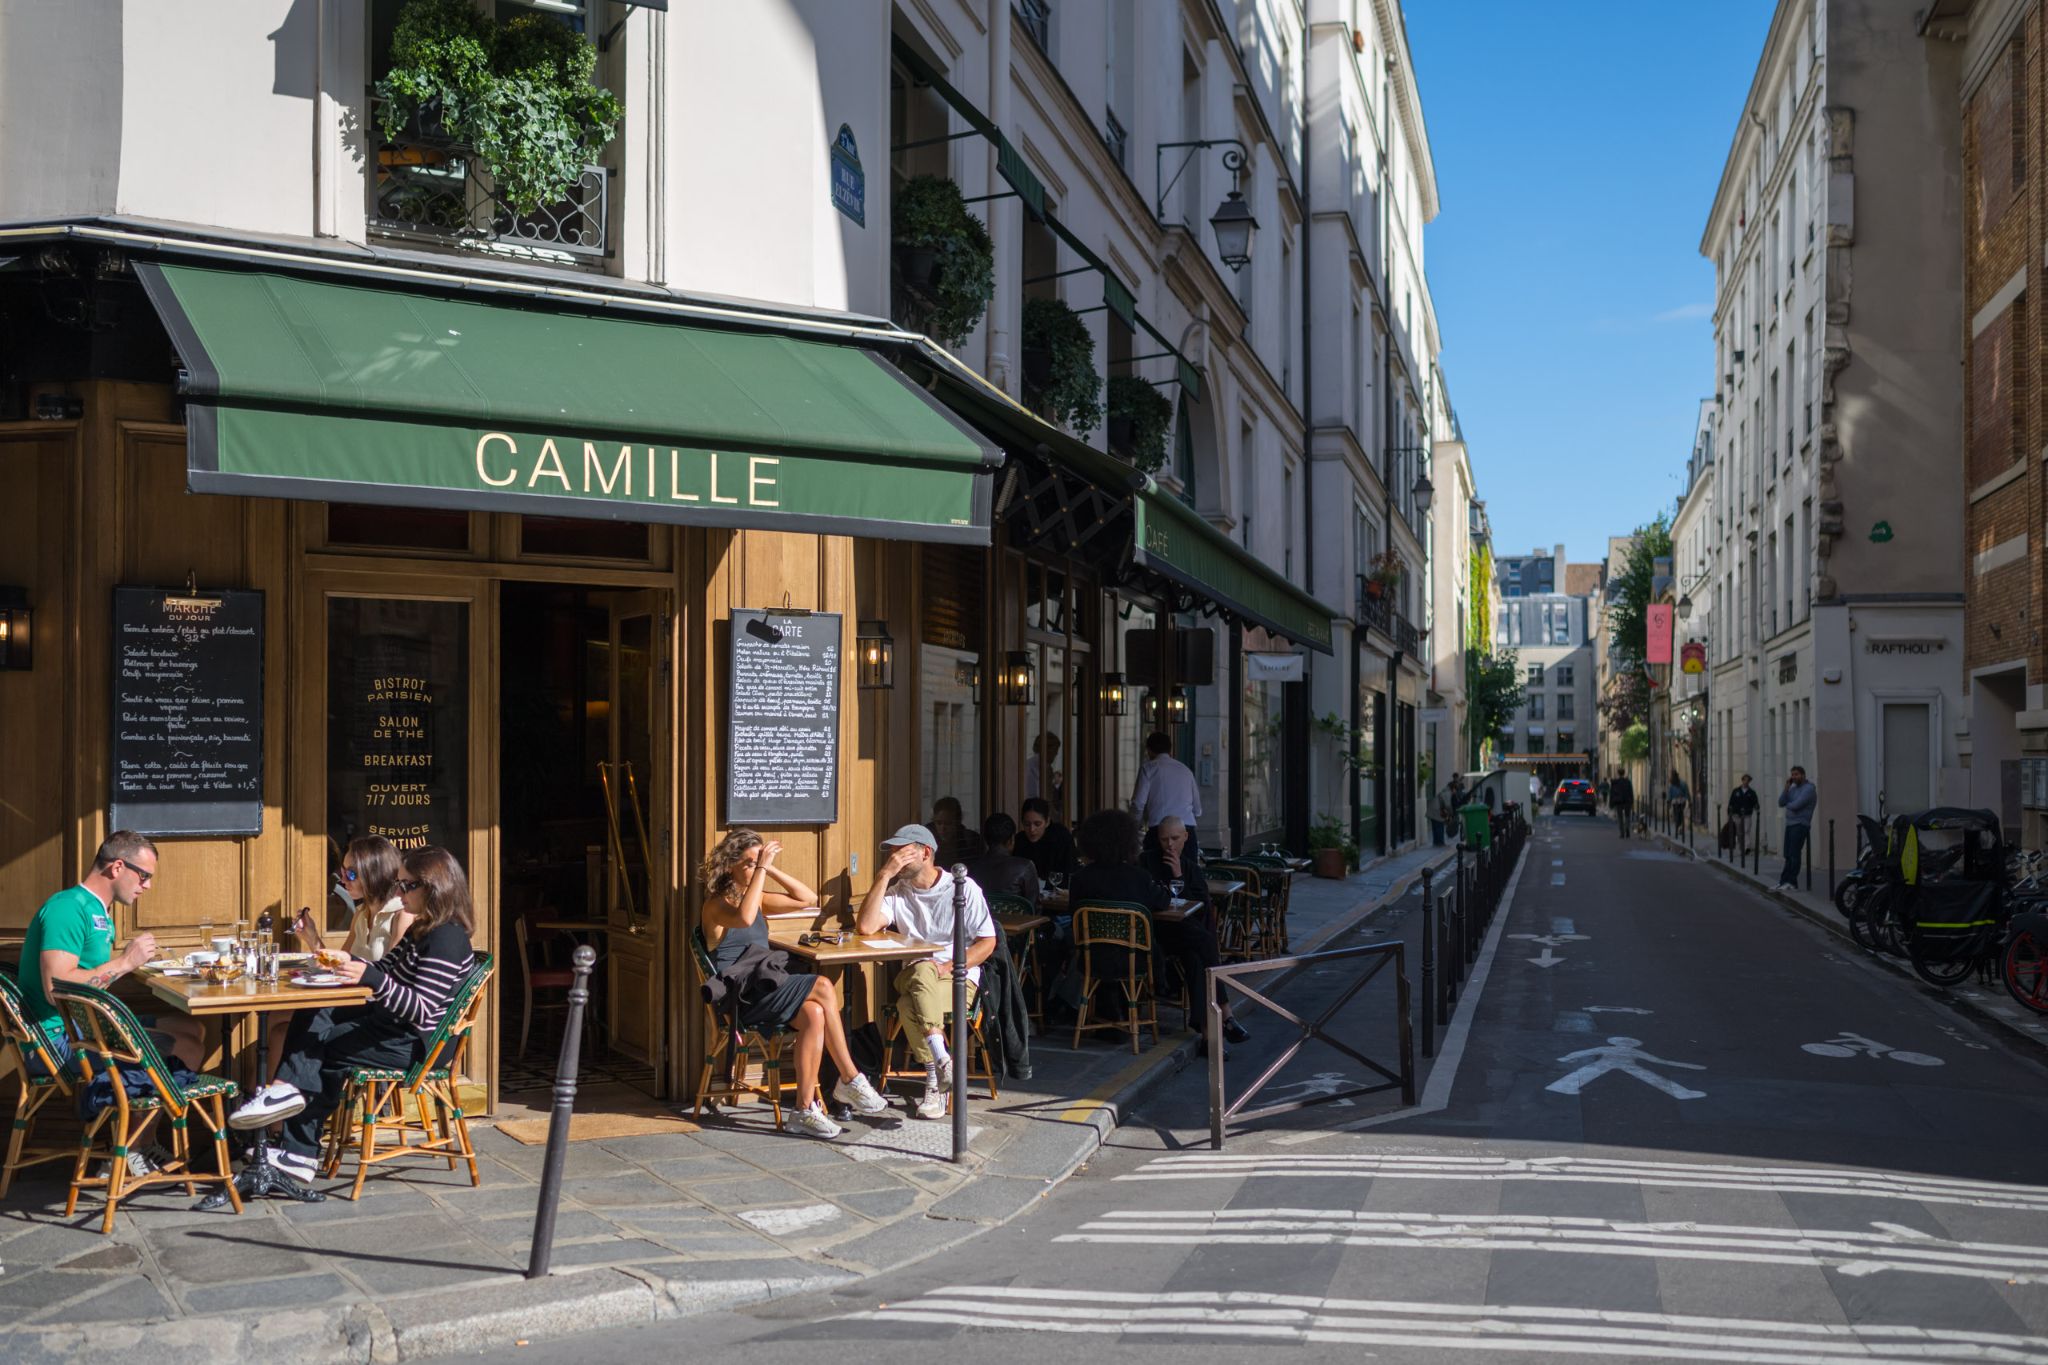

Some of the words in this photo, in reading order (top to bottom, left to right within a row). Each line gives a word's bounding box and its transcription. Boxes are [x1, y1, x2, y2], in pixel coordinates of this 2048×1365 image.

[842, 167, 854, 190] RUE
[476, 432, 780, 507] CAMILLE
[1146, 524, 1168, 557] CAFÉ
[772, 625, 802, 637] CARTE
[123, 646, 148, 656] Salade
[374, 678, 426, 691] BISTROT
[368, 692, 432, 703] PARISIEN
[380, 716, 418, 727] SALON
[374, 730, 391, 738] DE
[364, 755, 432, 766] BREAKFAST
[182, 782, 199, 792] Hugo
[371, 784, 426, 792] OUVERT
[366, 794, 384, 806] 7/7
[391, 794, 430, 805] JOURS
[369, 824, 429, 835] SERVICE
[389, 836, 426, 849] NTINU
